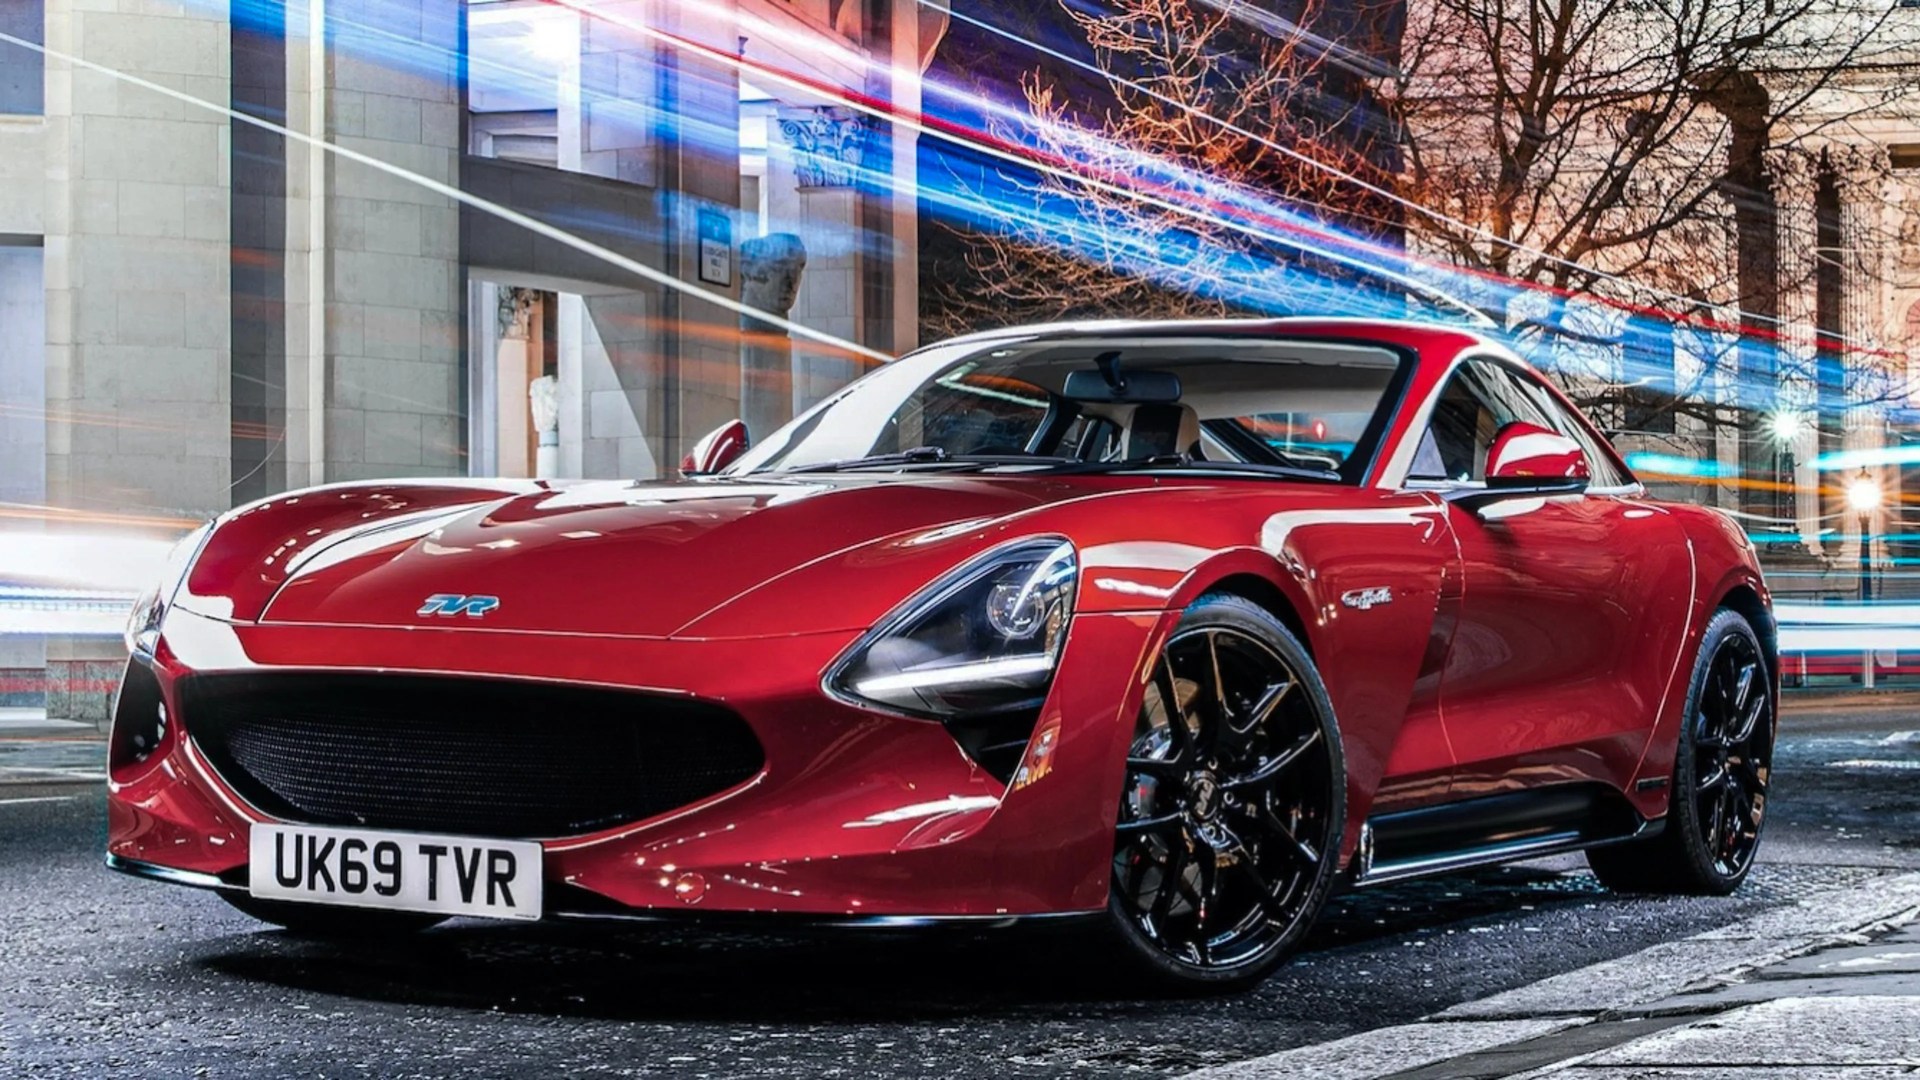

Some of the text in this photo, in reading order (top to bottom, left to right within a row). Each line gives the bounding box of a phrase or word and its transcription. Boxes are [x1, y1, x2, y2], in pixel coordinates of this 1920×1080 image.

[416, 593, 500, 617] TVR
[275, 832, 517, 908] UK69 TVR
